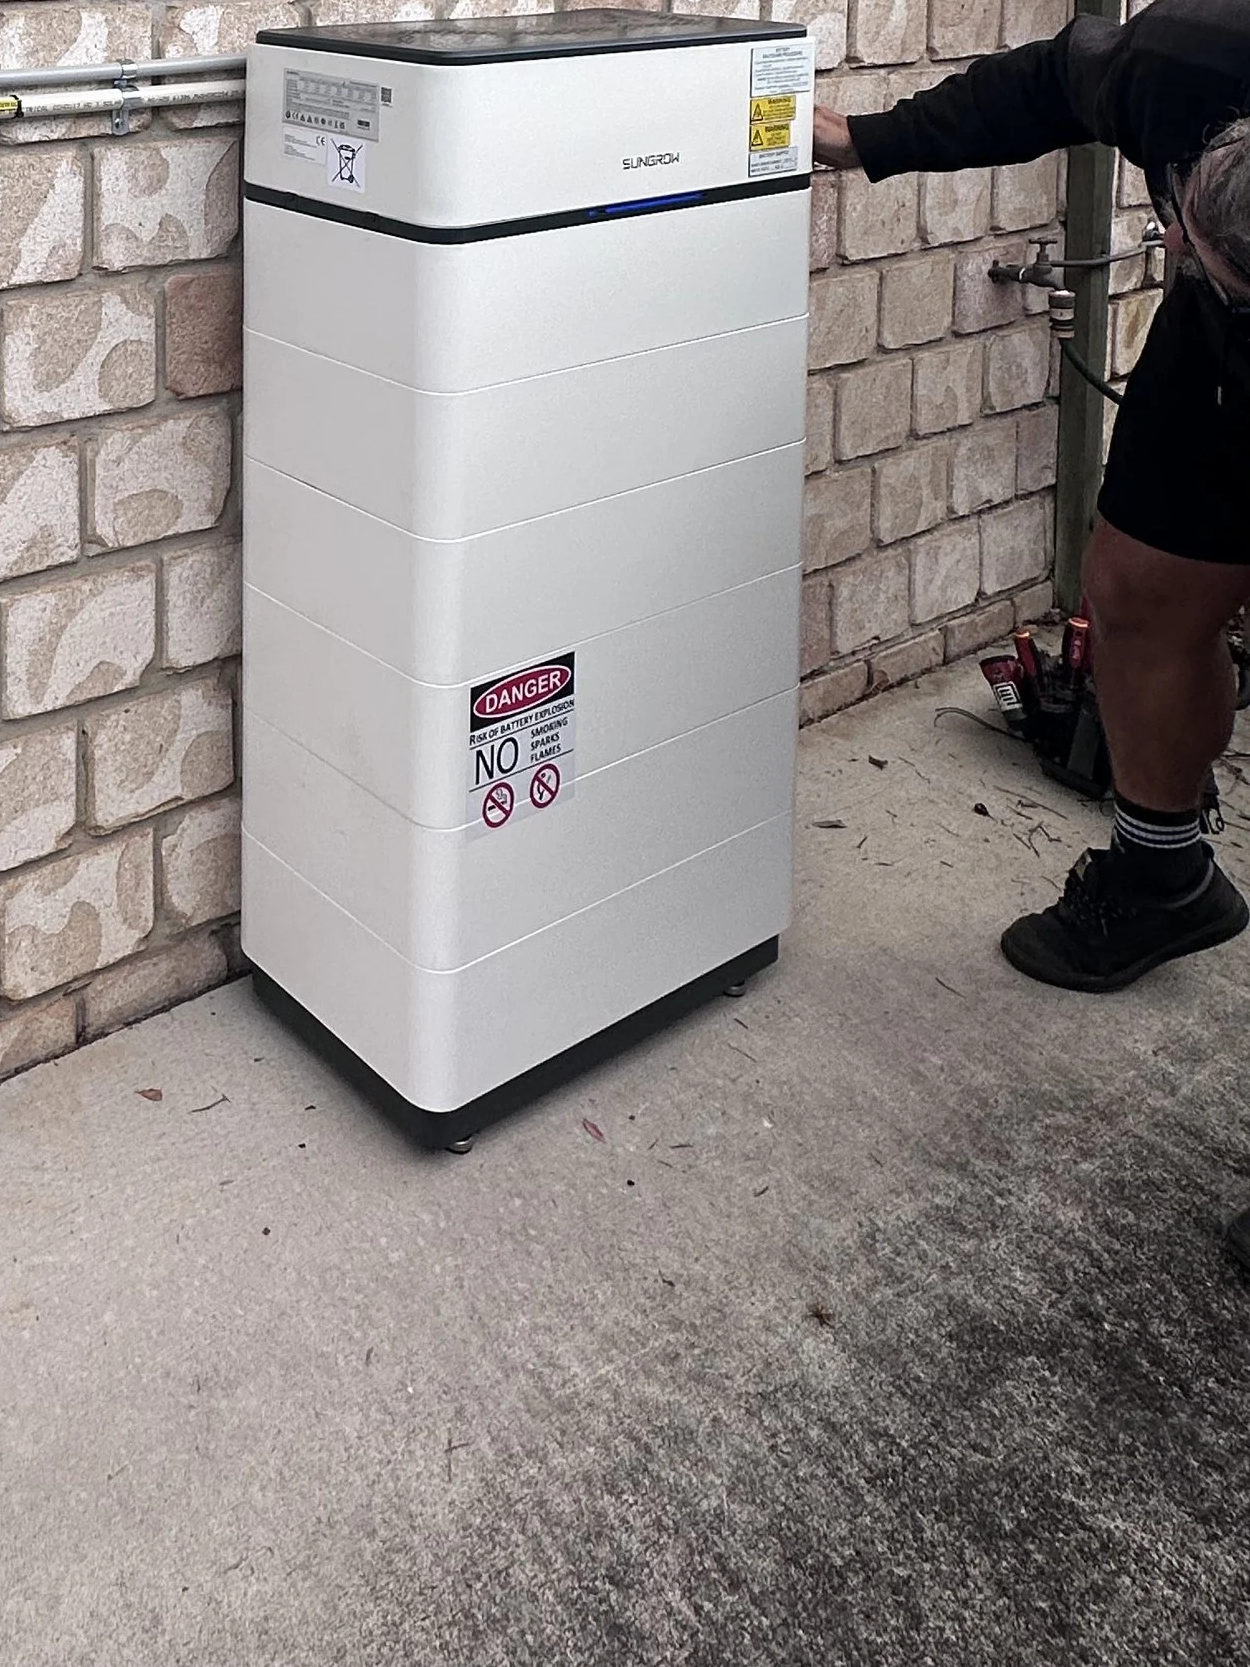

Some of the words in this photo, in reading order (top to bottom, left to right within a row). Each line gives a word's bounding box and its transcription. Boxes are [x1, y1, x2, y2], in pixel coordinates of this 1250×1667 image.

[622, 151, 680, 170] SUNGROW
[485, 670, 562, 713] DANGER
[489, 727, 499, 738] OF
[500, 715, 533, 732] BATTERY
[535, 698, 575, 721] EXPLOSION
[531, 716, 568, 739] SMOKING
[531, 732, 560, 751] SPARKS
[476, 737, 519, 785] NO
[531, 744, 561, 763] FLAMES
